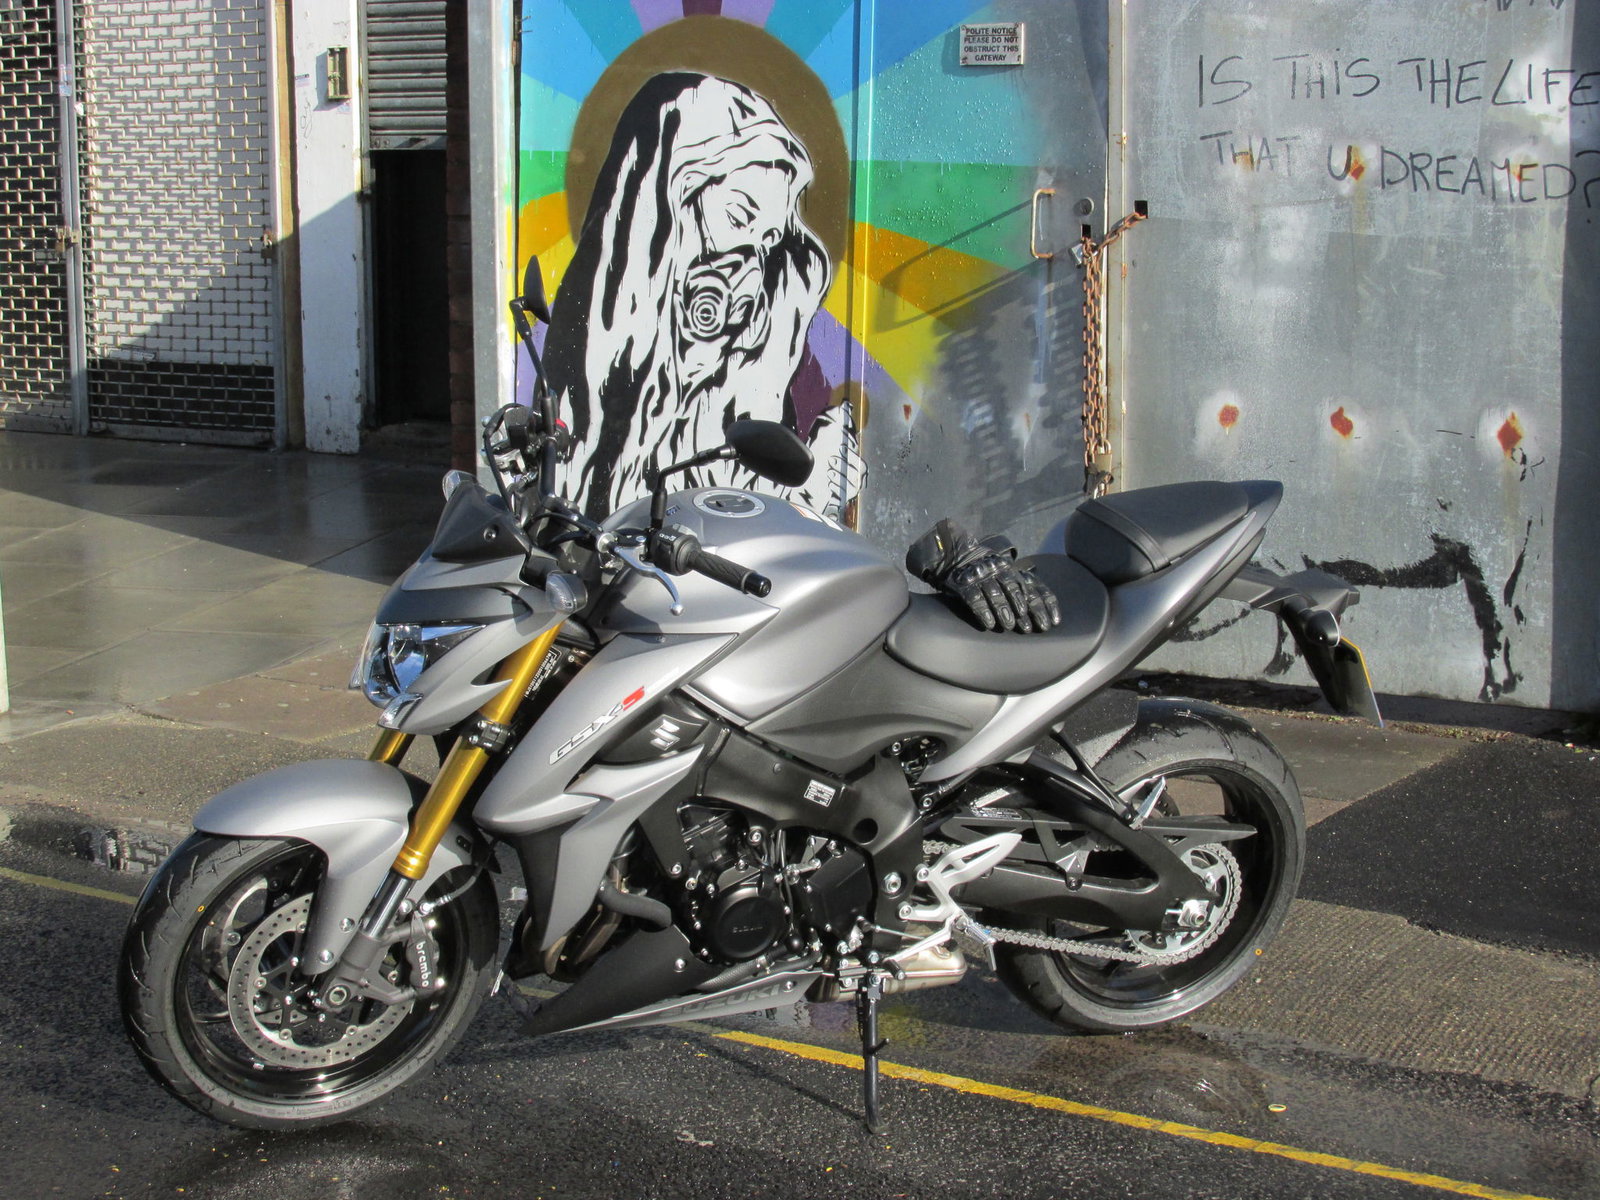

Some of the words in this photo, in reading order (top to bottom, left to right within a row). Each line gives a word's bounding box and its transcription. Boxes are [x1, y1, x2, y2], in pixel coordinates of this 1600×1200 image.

[964, 36, 989, 44] PLEASE
[965, 27, 989, 35] POLITE
[964, 45, 1000, 53] OBSTRUCT
[1199, 54, 1252, 108] IS
[1272, 49, 1380, 99] THIS
[1398, 57, 1487, 108] THE
[1491, 58, 1600, 107] LIFE
[1199, 130, 1300, 177] THAT
[1327, 144, 1353, 182] U
[416, 941, 432, 987] brembo
